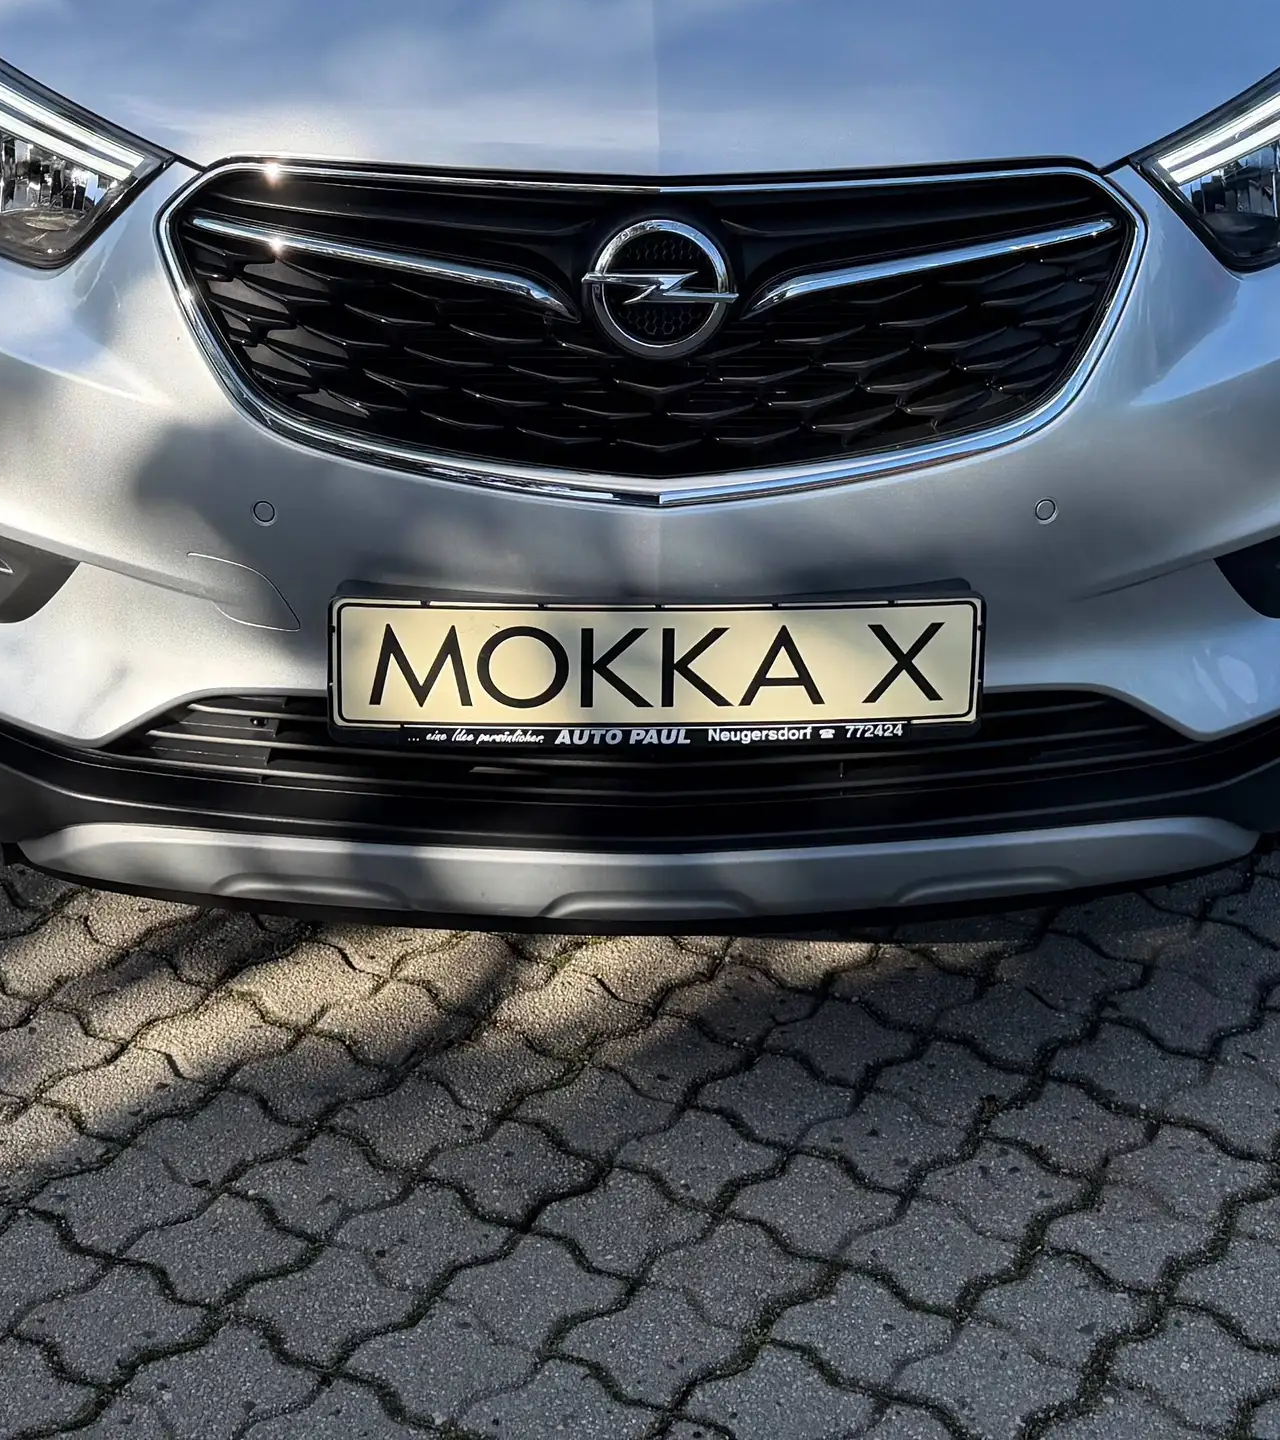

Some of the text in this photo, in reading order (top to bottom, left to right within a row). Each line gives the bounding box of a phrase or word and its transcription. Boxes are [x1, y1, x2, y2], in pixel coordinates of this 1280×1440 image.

[368, 621, 946, 709] MOKKA X
[554, 729, 623, 745] AUTO
[629, 729, 691, 745] PAUL
[707, 726, 813, 744] Neugersdorf
[845, 723, 903, 739] 772424
